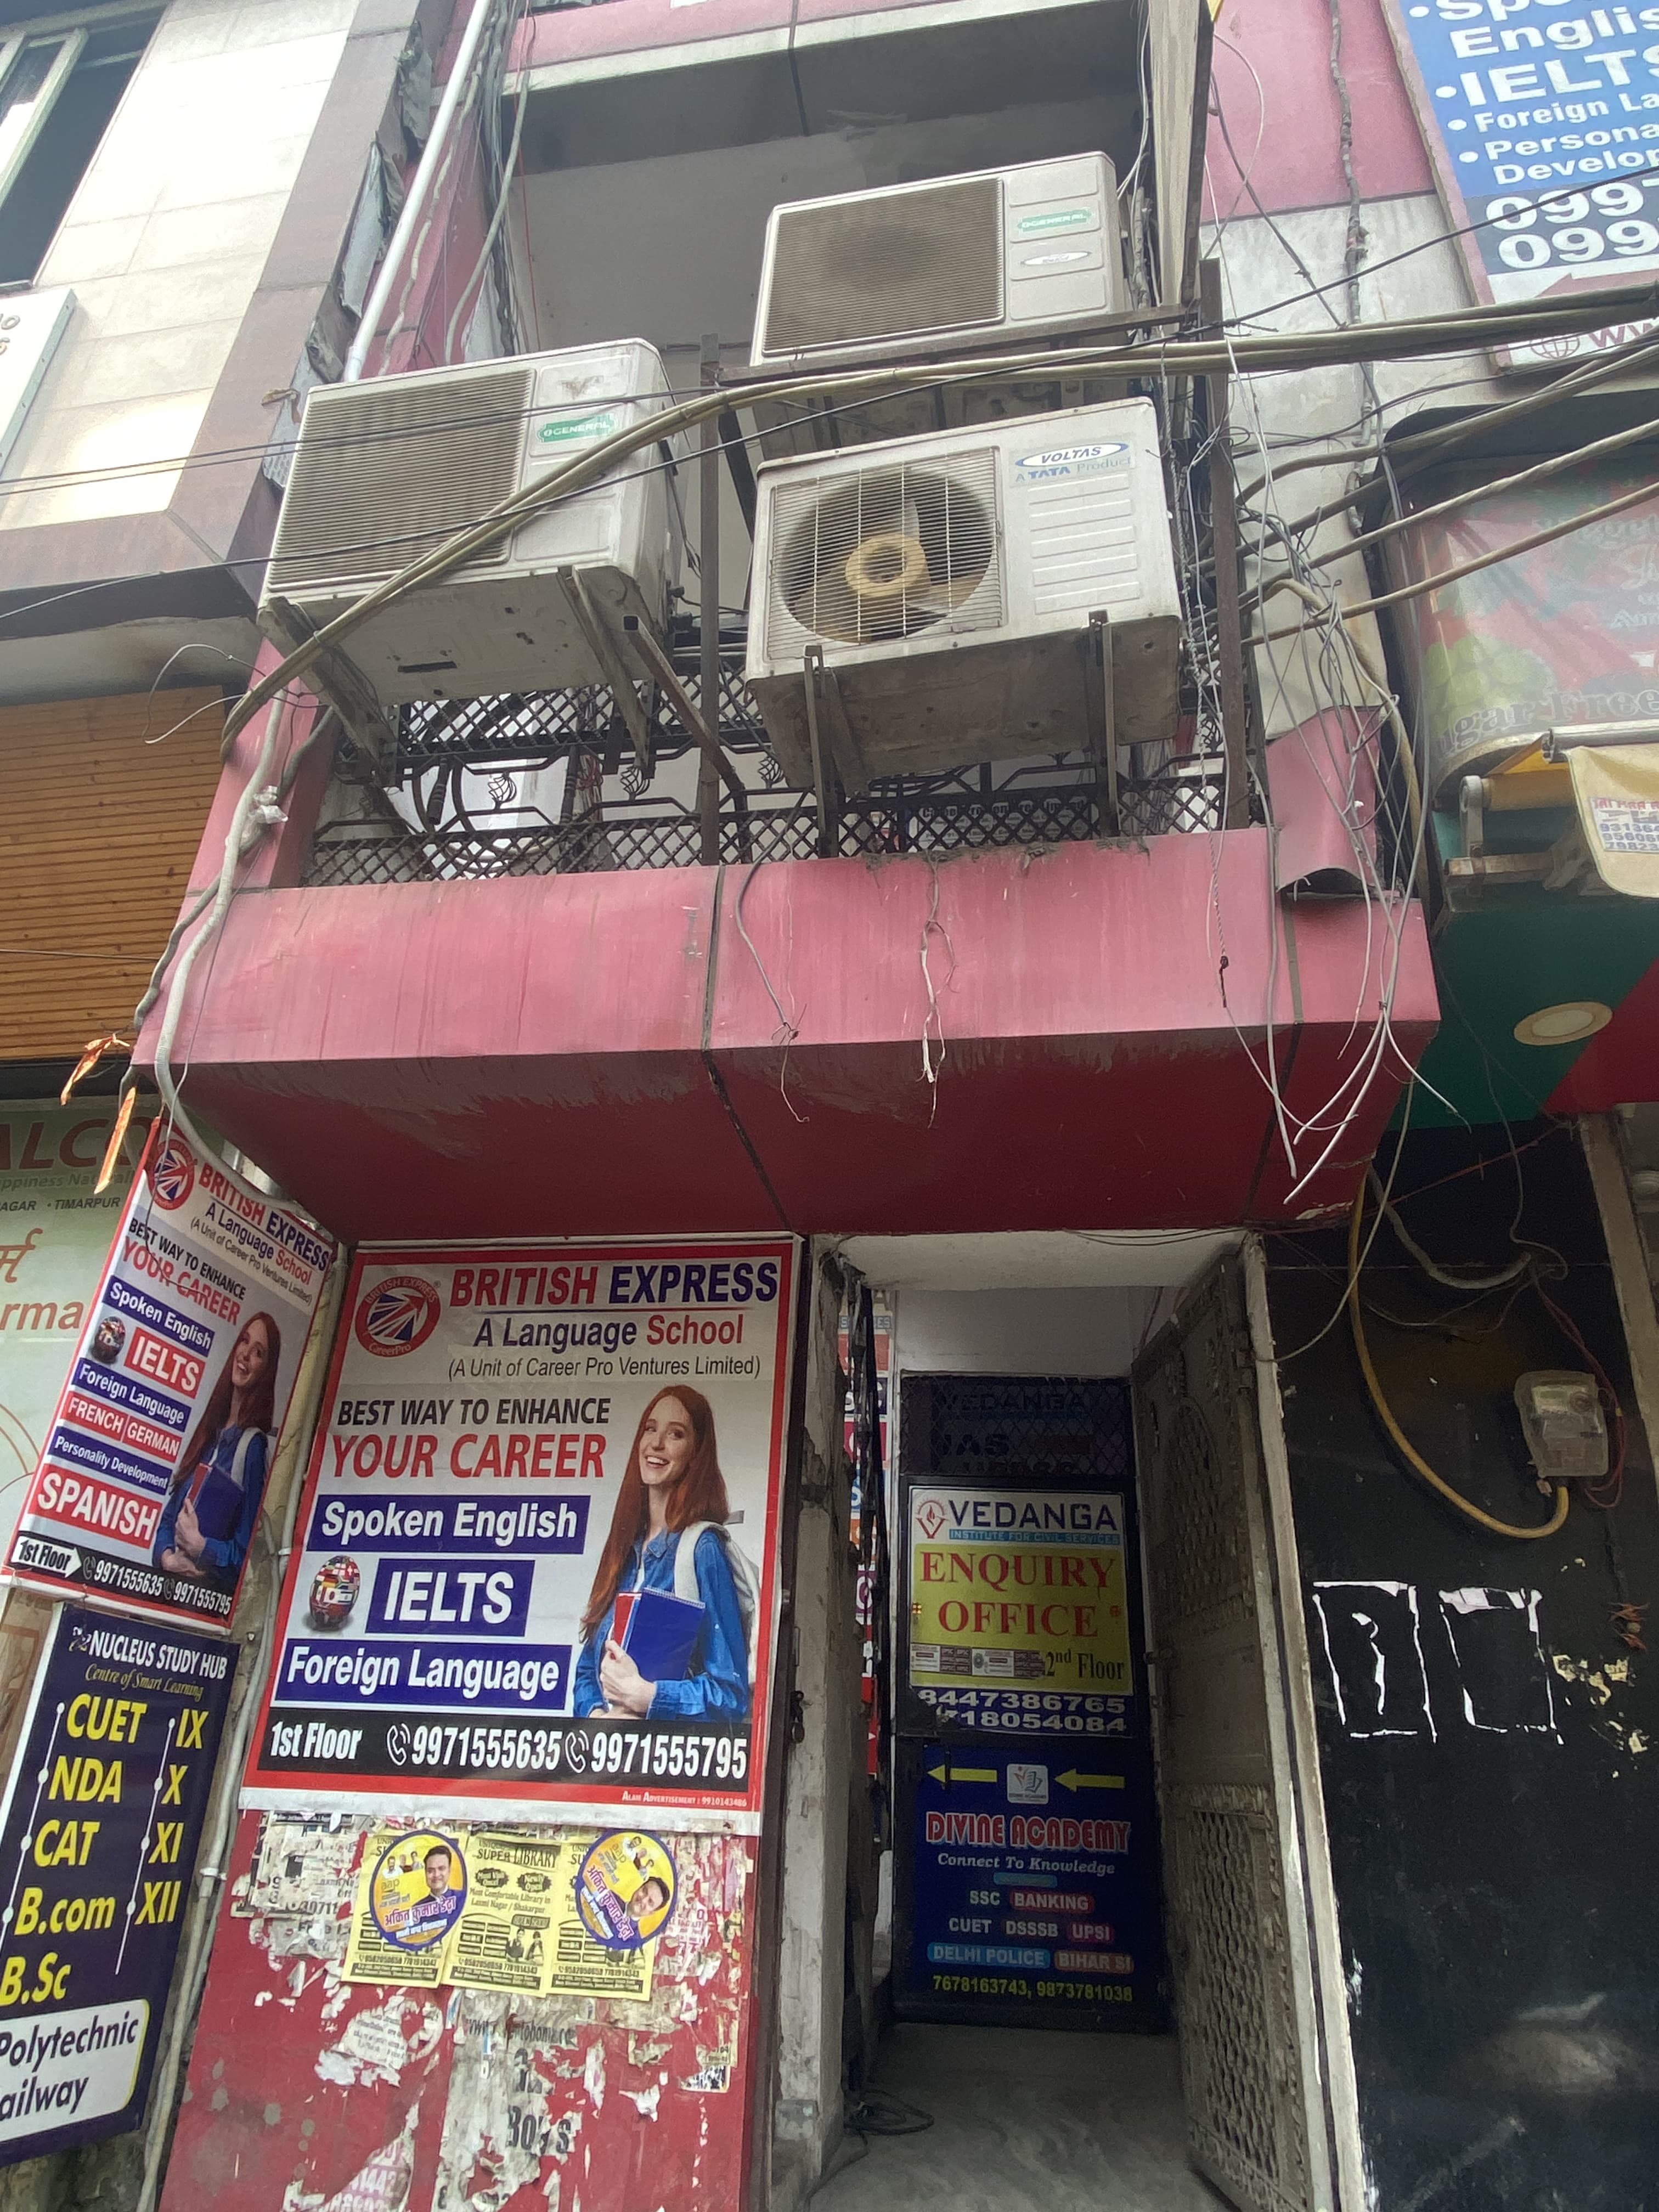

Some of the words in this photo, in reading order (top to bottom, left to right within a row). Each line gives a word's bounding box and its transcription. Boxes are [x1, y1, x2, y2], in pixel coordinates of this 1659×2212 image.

[1474, 100, 1609, 133] Foreign
[1028, 466, 1071, 480] TATA
[1076, 456, 1132, 473] Product
[1041, 445, 1102, 464] VOLTAS
[0, 1200, 37, 1212] AGAR
[55, 1197, 121, 1210] TIMARPUR
[199, 1163, 267, 1226] BRITISH
[266, 1211, 329, 1272] EXPRESS
[129, 1217, 157, 1247] BEST
[159, 1234, 183, 1262] WAY
[185, 1250, 199, 1271] TO
[199, 1262, 246, 1301] ENHANCE
[205, 1203, 216, 1217] A
[218, 1213, 274, 1260] Language
[275, 1250, 313, 1285] School
[225, 1240, 249, 1262] Career
[262, 1266, 289, 1289] Ventures
[123, 1237, 174, 1289] YOUR
[177, 1271, 241, 1326] CAREER
[450, 1266, 599, 1307] BRITISH
[608, 1262, 778, 1305] EXPRESS
[110, 1282, 162, 1324] Spoken
[165, 1310, 212, 1350] English
[473, 1318, 494, 1347] A
[502, 1317, 637, 1355] Language
[646, 1313, 744, 1346] School
[132, 1335, 200, 1392] IELTS
[448, 1358, 466, 1382] (A
[470, 1357, 502, 1378] Unit
[506, 1357, 523, 1377] of
[528, 1357, 581, 1377] Career
[585, 1357, 614, 1376] Pro
[619, 1356, 690, 1376] Ventures
[695, 1355, 761, 1379] Limited)
[78, 1363, 127, 1400] Foreign
[129, 1389, 184, 1425] Language
[337, 1399, 395, 1426] BEST
[400, 1398, 454, 1426] WAY
[460, 1398, 490, 1425] TO
[496, 1397, 612, 1425] ENHANCE
[67, 1397, 124, 1434] FRENCH
[127, 1421, 180, 1458] GERMAN
[54, 1435, 110, 1470] Personality
[111, 1458, 168, 1490] Development
[332, 1433, 439, 1479] YOUR
[450, 1432, 607, 1479] CAREER
[38, 1472, 159, 1542] SPANISH
[321, 1500, 444, 1545] Spoken
[453, 1502, 578, 1547] English
[949, 1499, 1118, 1531] VEDANGA
[950, 1529, 1005, 1541] INSTITUTE
[1009, 1531, 1030, 1542] FOR
[1034, 1532, 1064, 1543] CIVIL
[1065, 1533, 1121, 1545] SERVICES
[19, 1539, 37, 1564] 1st
[38, 1545, 71, 1572] Floor
[94, 1559, 165, 1598] 9971555635
[172, 1579, 233, 1615] 9971555795
[919, 1550, 1116, 1591] ENQUIRY
[383, 1571, 515, 1624] IELTS
[938, 1600, 1099, 1638] OFFICE
[89, 1629, 156, 1669] NUCLEUS
[156, 1644, 200, 1675] STUDY
[200, 1655, 228, 1680] HUB
[286, 1645, 401, 1696] Foreign
[408, 1649, 560, 1701] Language
[1043, 1648, 1073, 1677] 2nd
[1077, 1651, 1125, 1681] Floor
[86, 1663, 120, 1685] Centre
[121, 1668, 133, 1690] of
[132, 1674, 162, 1692] Smart
[165, 1677, 204, 1702] Learning
[917, 1689, 1126, 1714] 8447386765
[66, 1693, 147, 1743] CUET
[176, 1708, 210, 1750] IX
[270, 1722, 303, 1758] 1st
[303, 1723, 362, 1760] Floor
[411, 1725, 564, 1771] 9971555635
[590, 1731, 748, 1780] 9971555795
[48, 1755, 123, 1804] NDA
[161, 1763, 188, 1805] X
[33, 1819, 100, 1868] CAT
[148, 1822, 185, 1865] XI
[926, 1811, 1005, 1846] DIVINE
[1010, 1816, 1131, 1853] ACADEMY
[476, 1848, 511, 1863] SUPER
[514, 1847, 557, 1868] LIBRARY
[938, 1852, 1000, 1869] Connect
[1006, 1856, 1024, 1870] To
[1029, 1858, 1115, 1877] Knowledge
[14, 1886, 116, 1936] B.com
[134, 1880, 182, 1926] XII
[969, 1890, 1001, 1906] SSC
[1014, 1892, 1089, 1910] BANKING
[949, 1917, 992, 1933] CUET
[1006, 1920, 1058, 1937] DSSSB
[1072, 1925, 1110, 1941] UPSI
[0, 1951, 71, 2007] B.Sc
[934, 1945, 980, 1963] DELHI
[986, 1948, 1046, 1966] POLICE
[1058, 1953, 1110, 1970] BIHAR
[1116, 1955, 1131, 1970] SI
[0, 2011, 139, 2073] Polytechnic
